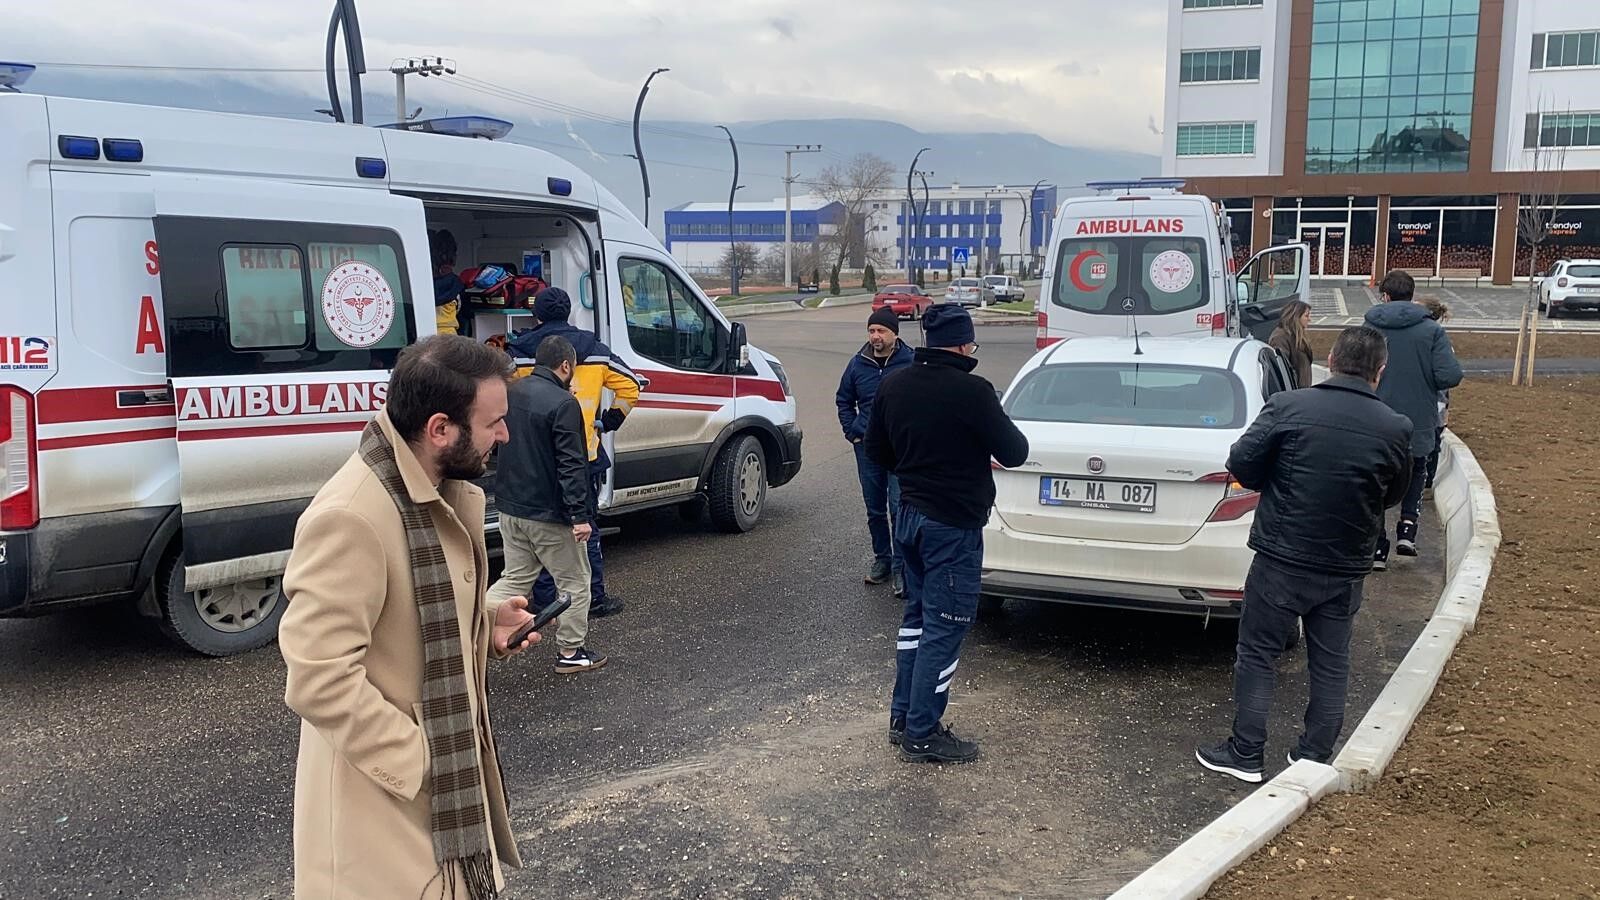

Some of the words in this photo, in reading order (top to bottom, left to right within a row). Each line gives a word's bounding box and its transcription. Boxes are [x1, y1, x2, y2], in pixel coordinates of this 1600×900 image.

[1076, 218, 1183, 235] AMBULANS
[1398, 222, 1431, 231] trendyol
[1092, 264, 1105, 273] 112
[1198, 314, 1210, 323] 112
[0, 337, 48, 363] 112
[179, 382, 388, 420] AMBULANS
[1090, 460, 1102, 470] FIAT
[1053, 480, 1071, 499] 14
[1086, 482, 1105, 501] NA
[1121, 484, 1153, 504] 087
